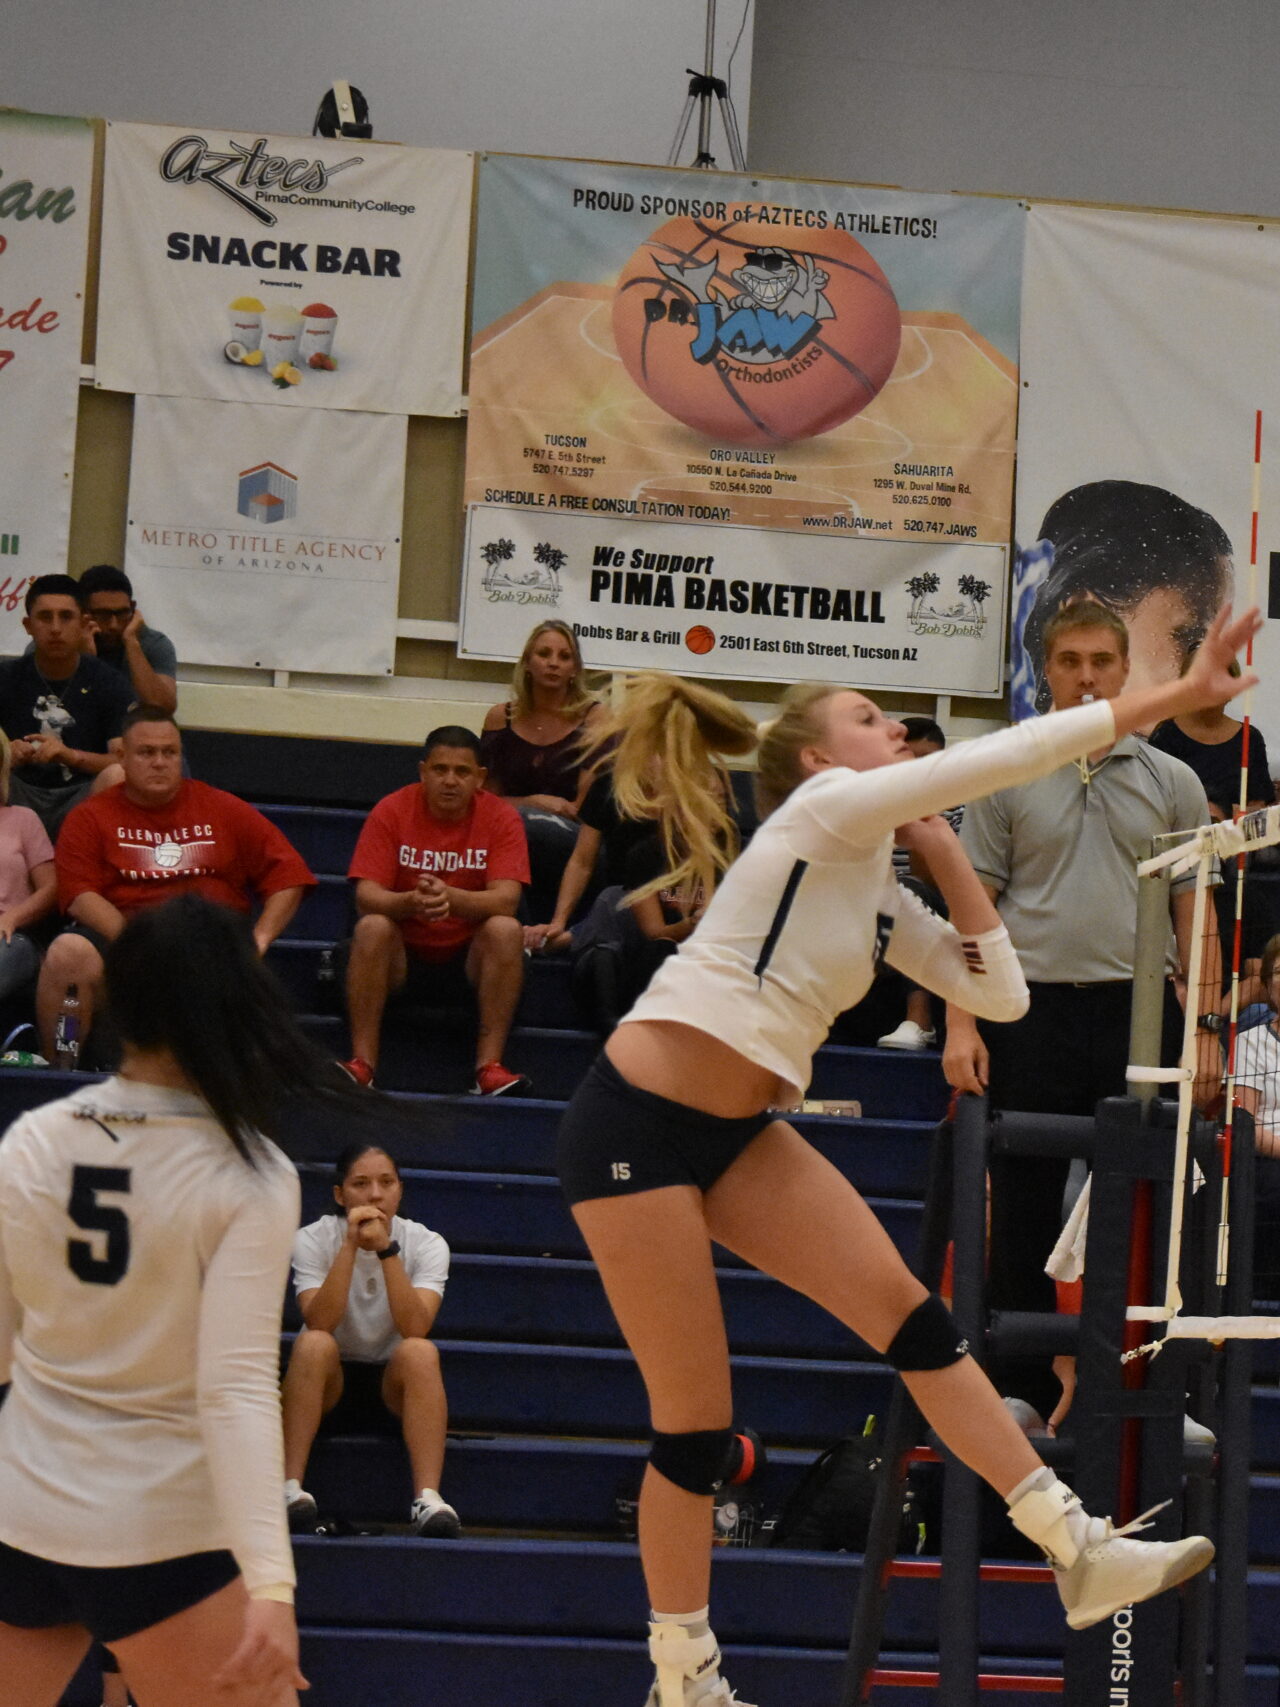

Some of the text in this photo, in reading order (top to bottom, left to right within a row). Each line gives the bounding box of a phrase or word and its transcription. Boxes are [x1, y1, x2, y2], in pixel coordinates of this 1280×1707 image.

[255, 191, 416, 215] PimaCommunityCollege
[573, 188, 937, 239] PROUD SPONSOR of AZTECS ATHLETICS!
[167, 232, 402, 278] SNACK BAR
[689, 302, 823, 366] JAW
[715, 344, 823, 384] Orthodontists
[543, 434, 587, 448] TUCSON
[523, 448, 545, 460] 5747
[557, 452, 574, 463] 5th
[575, 453, 607, 465] Street
[709, 449, 776, 465] ORO VALLEY
[715, 466, 724, 477] N.
[726, 467, 738, 478] La
[740, 467, 773, 480] Cañada
[775, 469, 797, 482] Drive
[893, 462, 954, 478] SAHUARITA
[709, 481, 772, 495] 520.544.9200
[873, 478, 894, 489] 1295
[909, 481, 934, 493] Duval
[935, 482, 957, 494] Mine
[958, 483, 972, 495] Rd.
[484, 488, 731, 521] SCHEDULE A FREE CONSULTATION TODAY!
[802, 516, 977, 538] www.DRJAW.net 520.747.JAWS
[140, 528, 387, 562] METRO TITLE AGENCY
[202, 555, 325, 573] OF ARIZONA
[593, 545, 714, 575] We Support
[488, 590, 515, 602] Bob
[590, 569, 885, 624] PIMA BASKETBALL
[573, 622, 681, 645] Dobbs Bar & Grill
[915, 622, 940, 635] Bob
[719, 635, 918, 661] 2501 East 6th Street, Tucson AZ
[117, 824, 213, 844] GLENDALE CC
[399, 844, 488, 872] GLENDALE
[611, 1162, 631, 1180] 15
[66, 1164, 131, 1287] 5
[1111, 1603, 1134, 1681] ports
